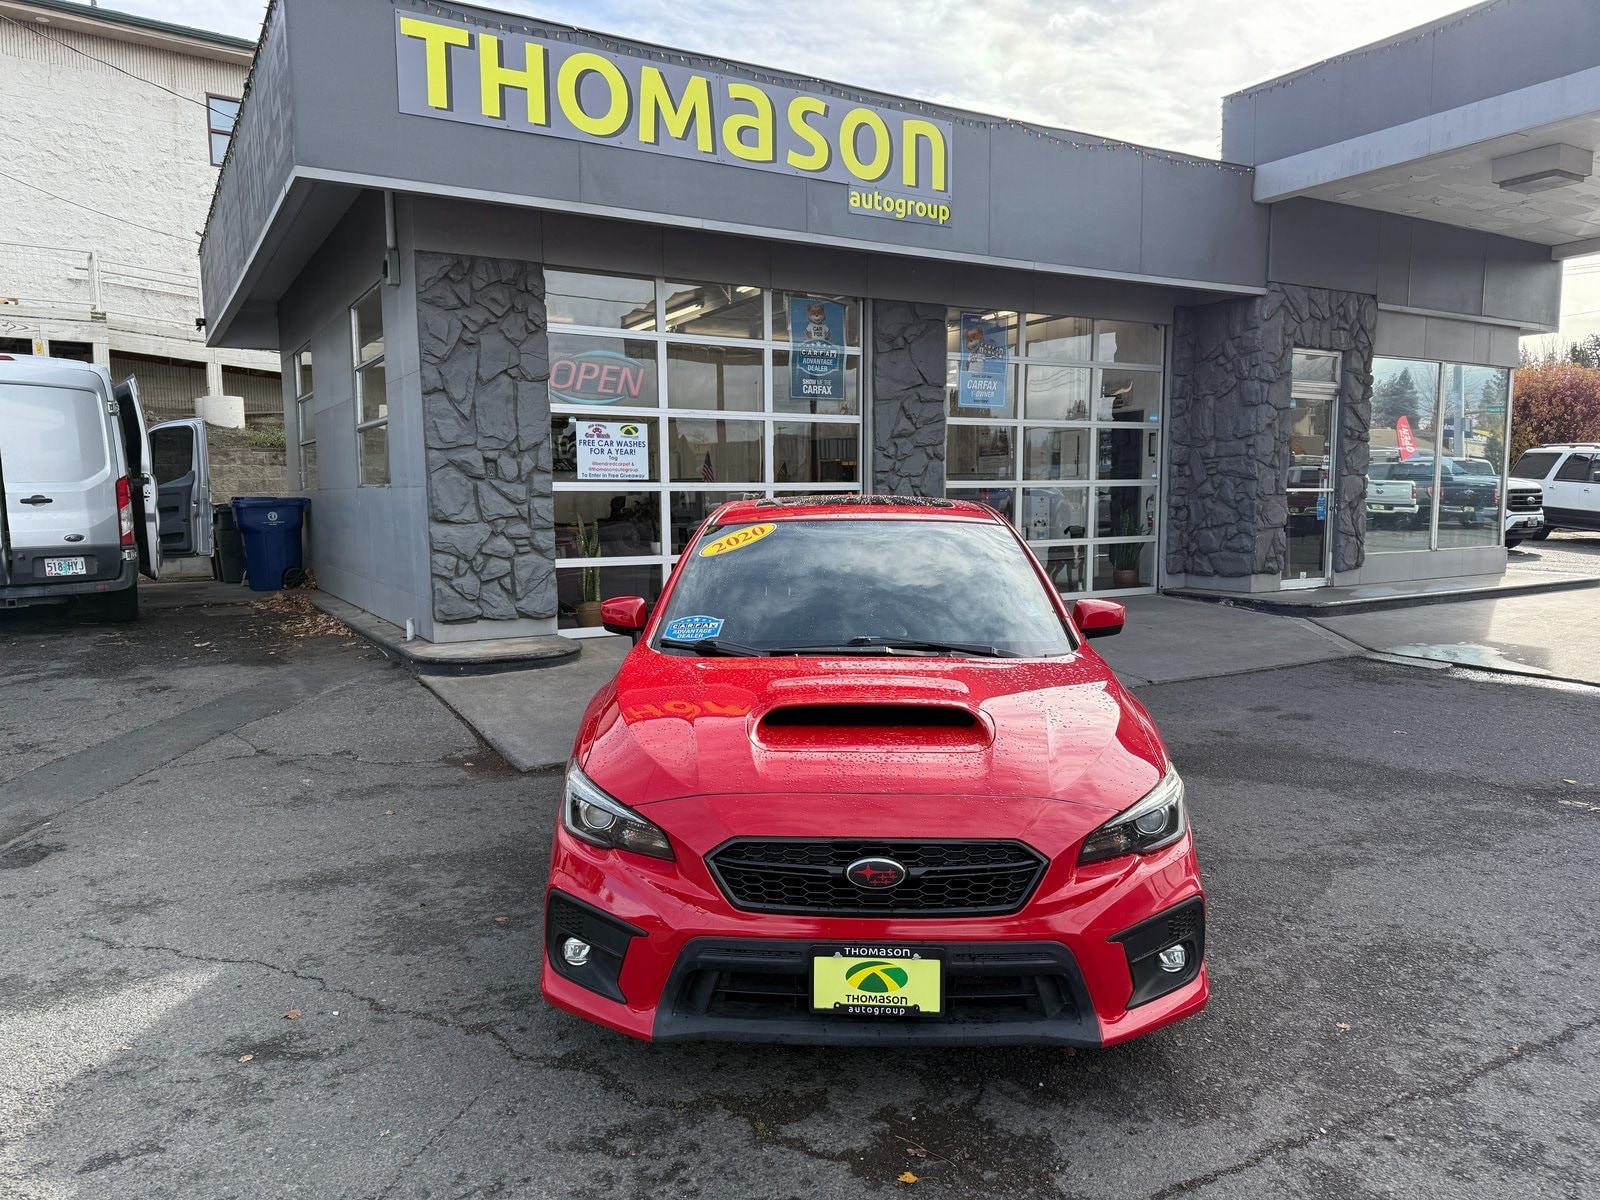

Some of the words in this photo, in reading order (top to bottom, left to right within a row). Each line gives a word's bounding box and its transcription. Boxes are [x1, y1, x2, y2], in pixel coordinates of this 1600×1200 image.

[849, 190, 950, 224] autogroup
[801, 349, 837, 358] CARFAX
[807, 364, 828, 372] DEALER
[549, 360, 645, 398] OPEN
[967, 379, 998, 390] CARFAX
[802, 385, 832, 395] CARFAX
[615, 448, 636, 456] YEAR!
[712, 526, 765, 553] 2020
[47, 562, 63, 572] 518
[67, 560, 84, 571] HYJ
[848, 1005, 906, 1016] autogroup
